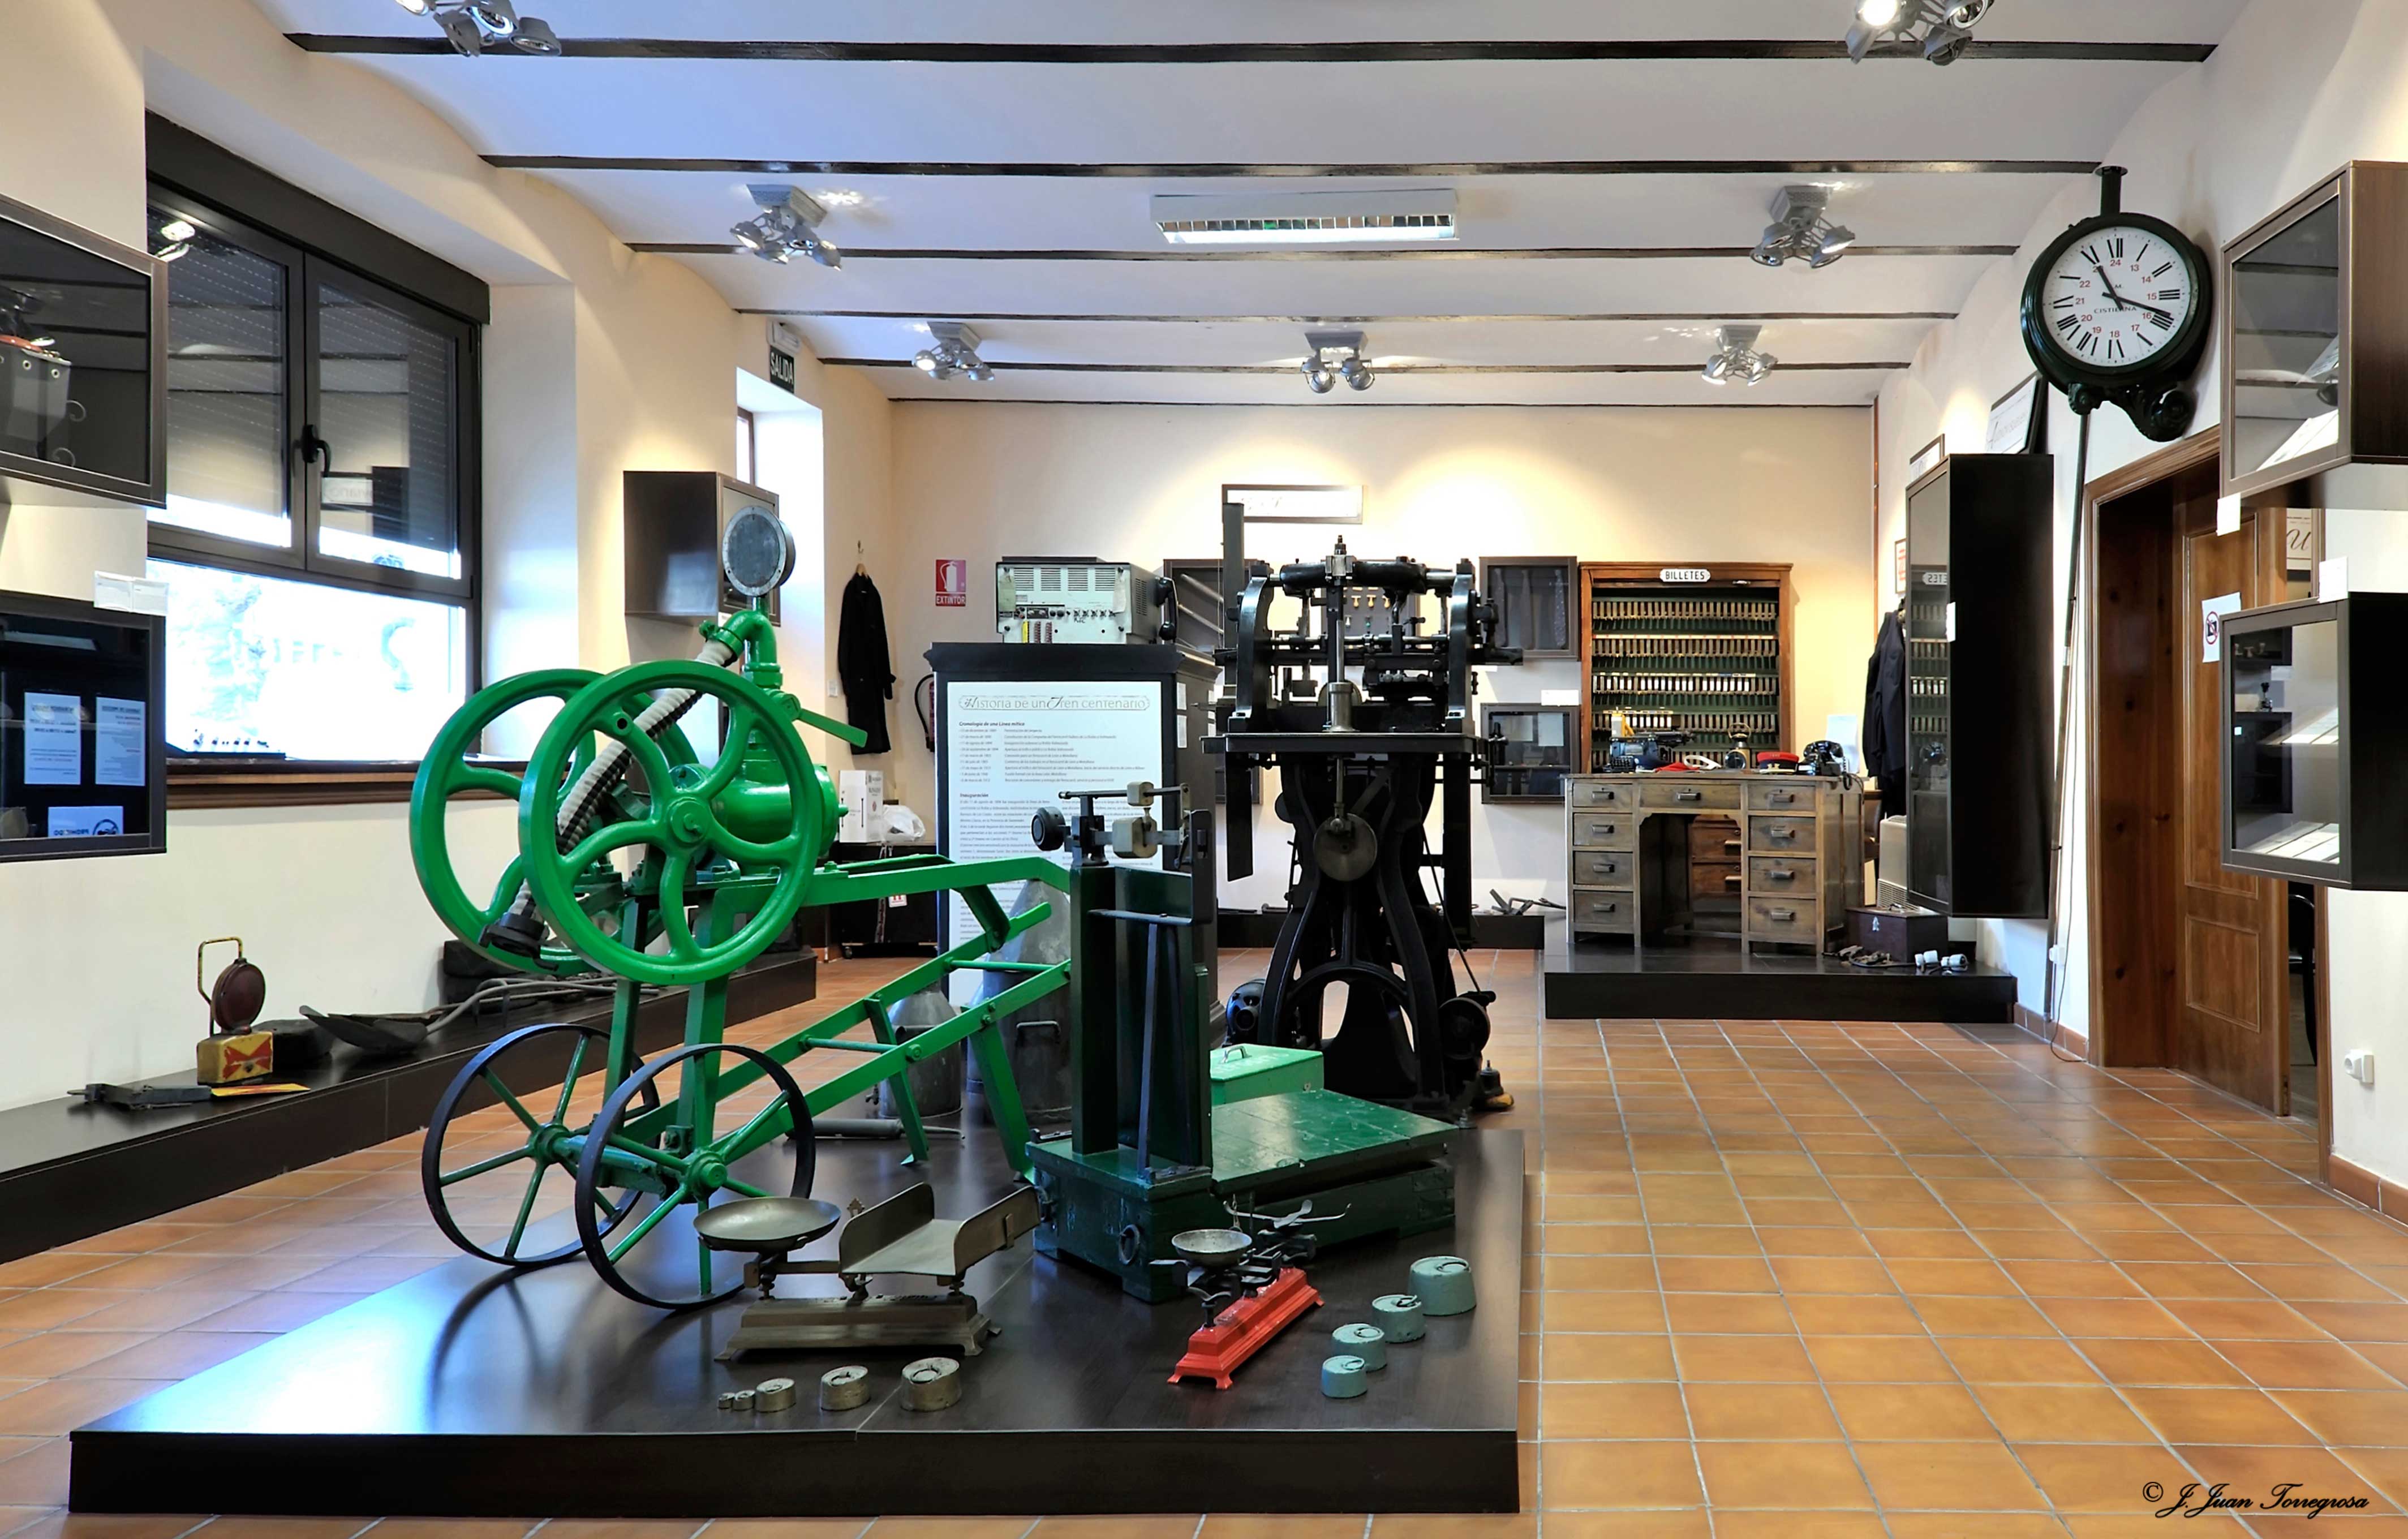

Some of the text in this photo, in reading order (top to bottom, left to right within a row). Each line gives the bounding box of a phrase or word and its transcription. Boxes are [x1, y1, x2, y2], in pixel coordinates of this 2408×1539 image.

[1666, 571, 1705, 580] BILLETES
[936, 595, 966, 605] EXTINTOR
[965, 697, 1011, 708] Historia
[1082, 700, 1145, 708] centenario
